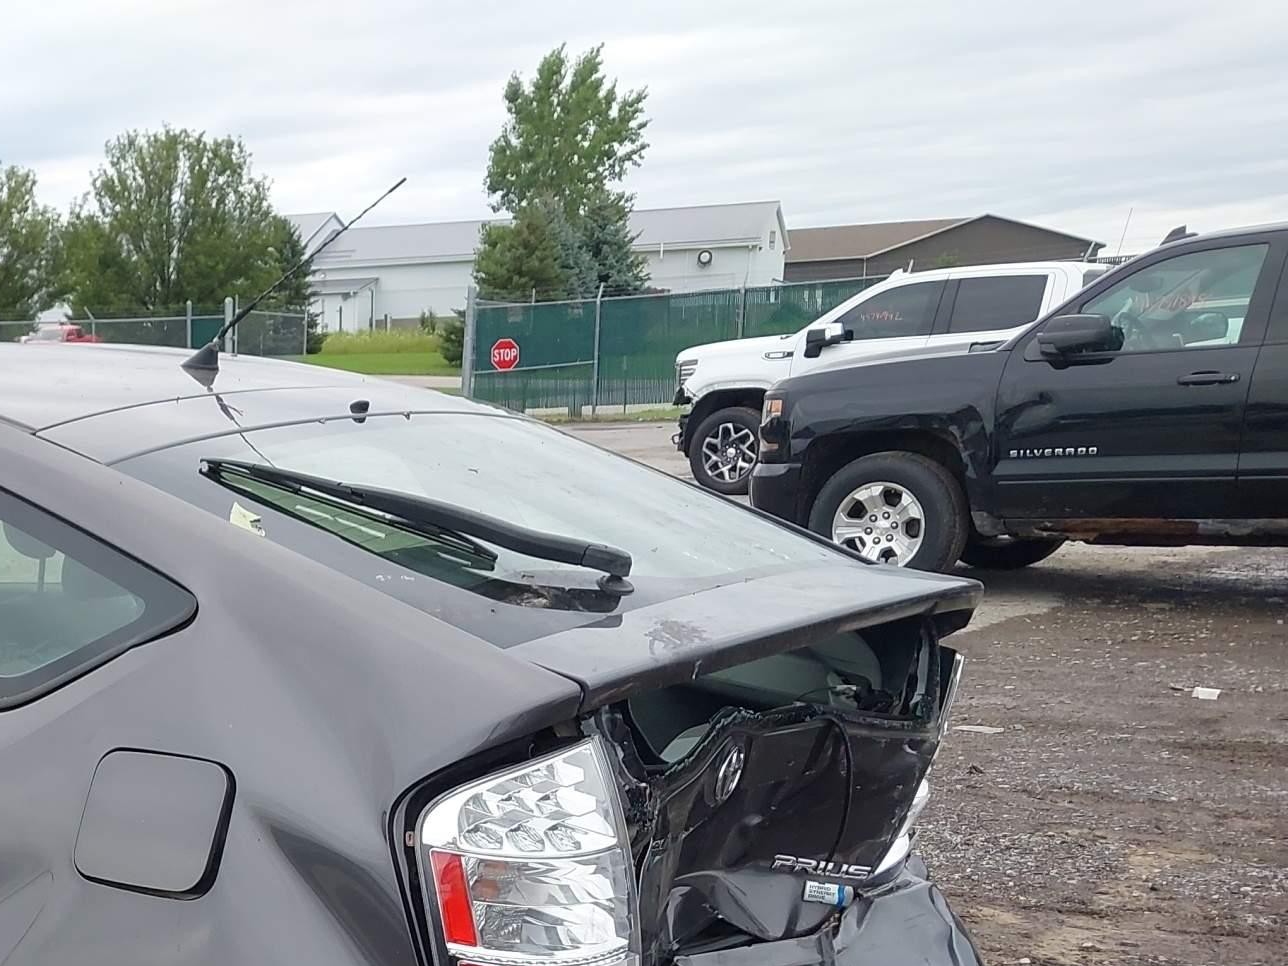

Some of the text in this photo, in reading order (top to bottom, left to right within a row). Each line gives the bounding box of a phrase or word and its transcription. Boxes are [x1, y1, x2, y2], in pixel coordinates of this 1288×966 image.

[493, 348, 517, 362] STOP
[1009, 447, 1098, 458] SILVERADO
[771, 854, 872, 880] PRIUS
